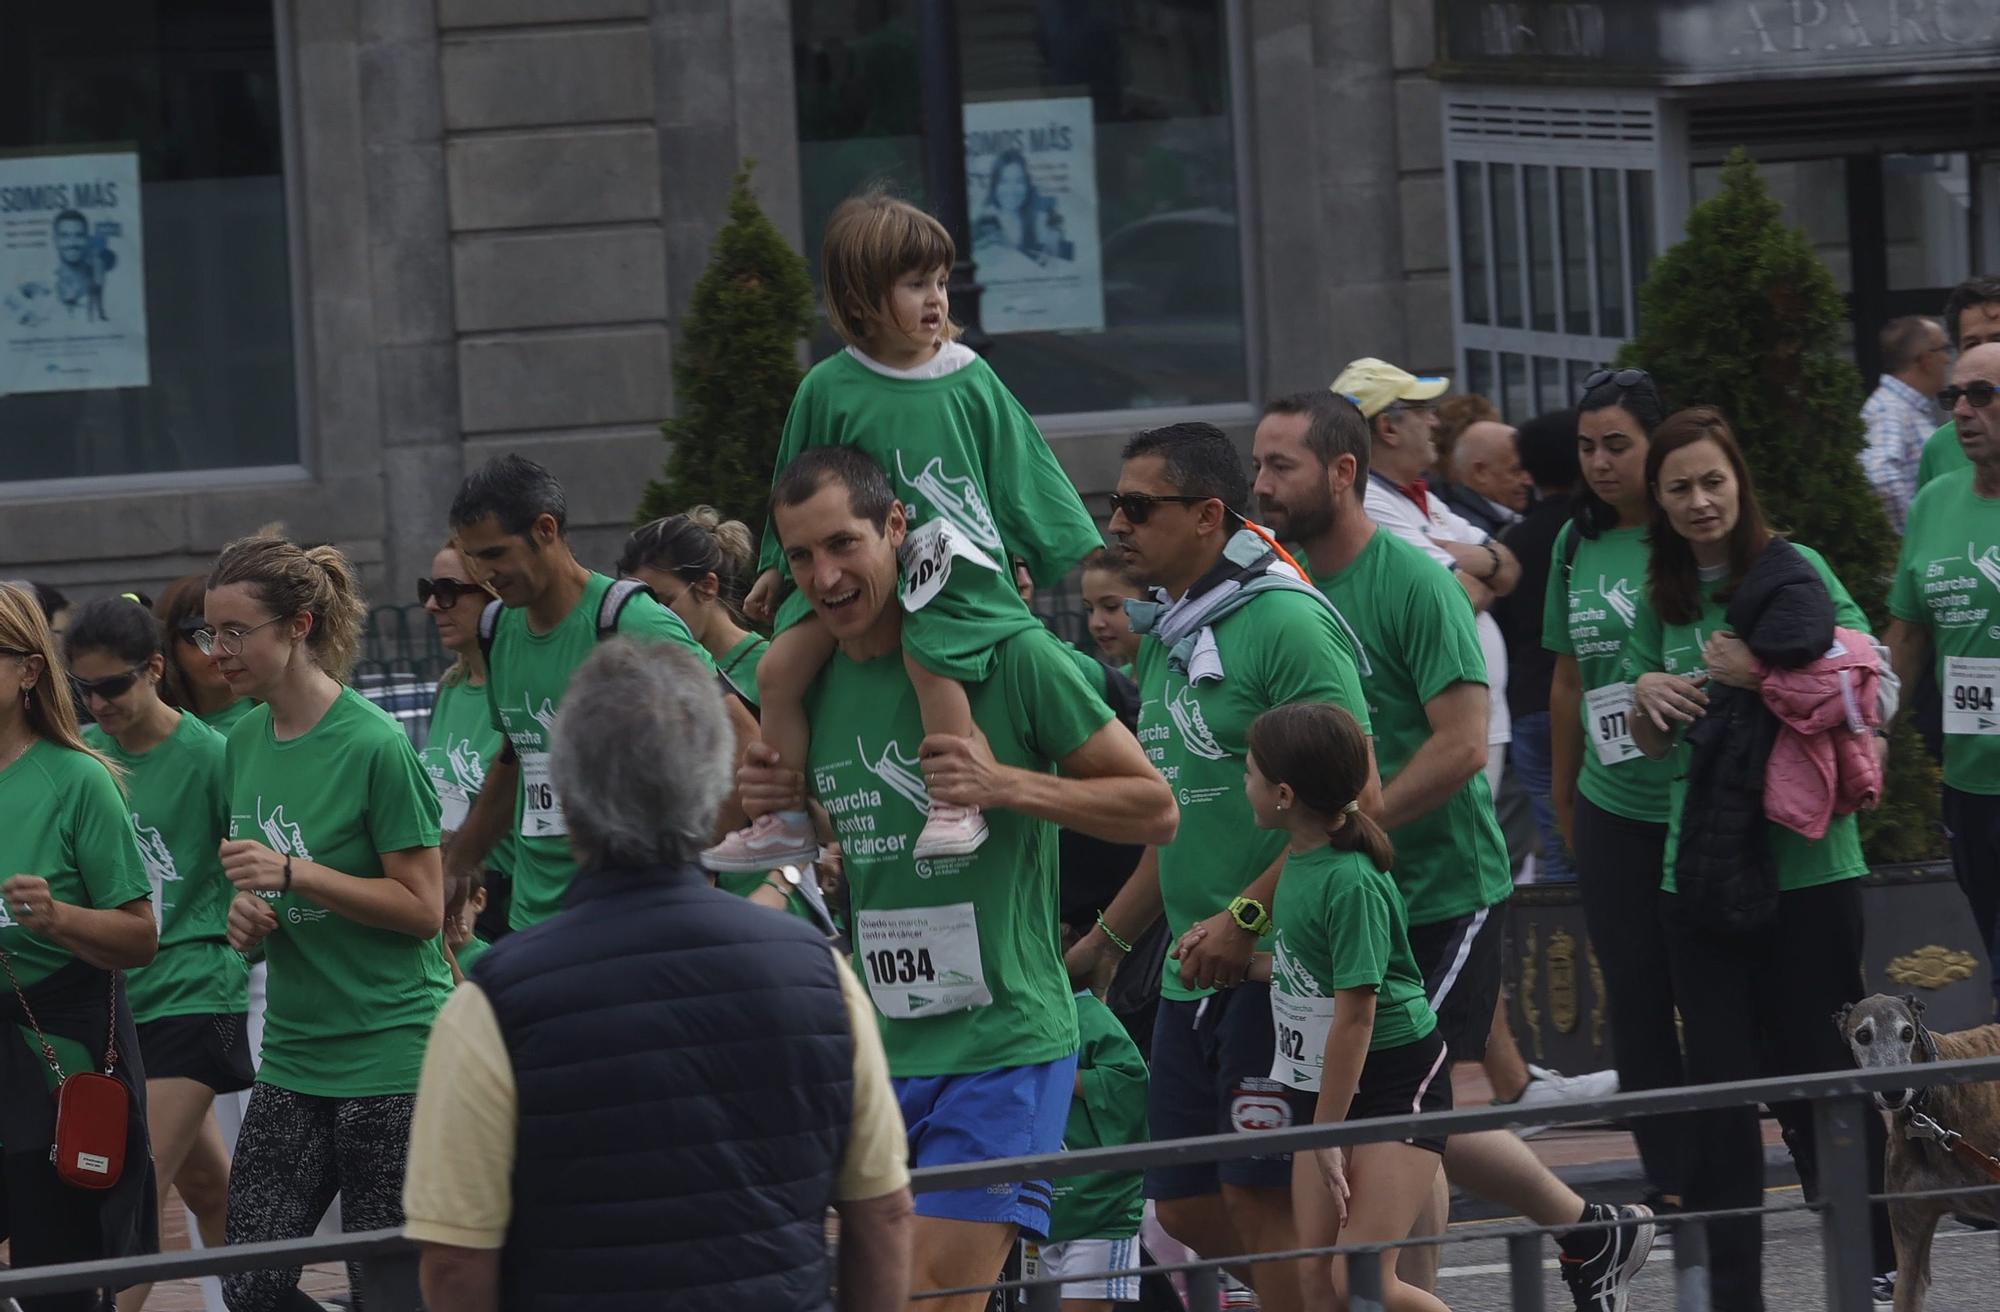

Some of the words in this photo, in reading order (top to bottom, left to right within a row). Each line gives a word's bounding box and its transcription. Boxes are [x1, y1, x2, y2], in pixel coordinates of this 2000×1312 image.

[1730, 0, 1993, 54] APARC
[0, 185, 68, 212] SOMOS
[74, 180, 118, 208] MÁS
[1954, 684, 1994, 711] 994
[1138, 723, 1170, 743] archa
[1600, 710, 1627, 740] 977
[816, 773, 836, 794] En
[822, 788, 882, 815] marcha
[837, 814, 875, 833] contra
[842, 836, 852, 856] el
[854, 833, 907, 855] cáncer
[867, 948, 935, 985] 1034
